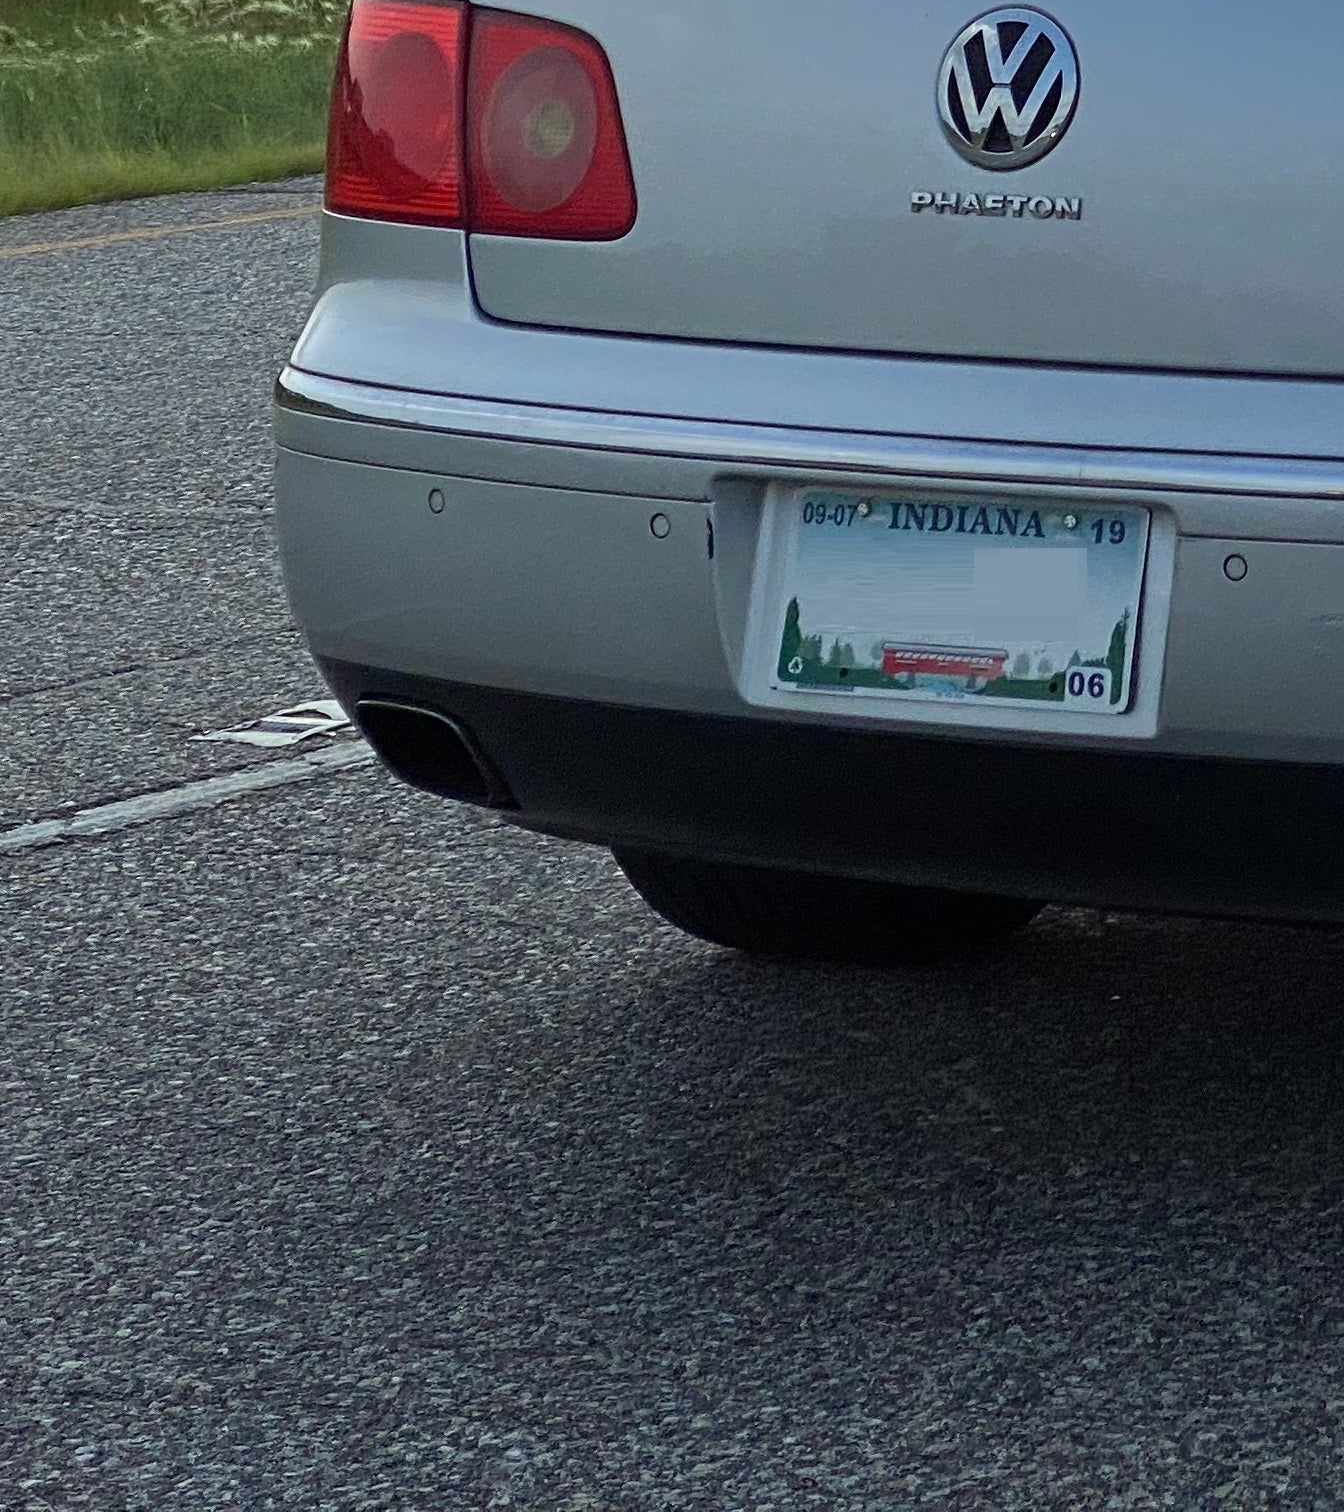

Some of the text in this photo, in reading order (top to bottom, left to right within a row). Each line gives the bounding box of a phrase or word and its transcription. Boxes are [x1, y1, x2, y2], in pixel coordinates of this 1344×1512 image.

[940, 8, 1077, 167] VW
[910, 191, 1082, 220] PHAETON
[802, 501, 1126, 545] 09-07 INDIANA 19
[1067, 671, 1105, 698] 06
